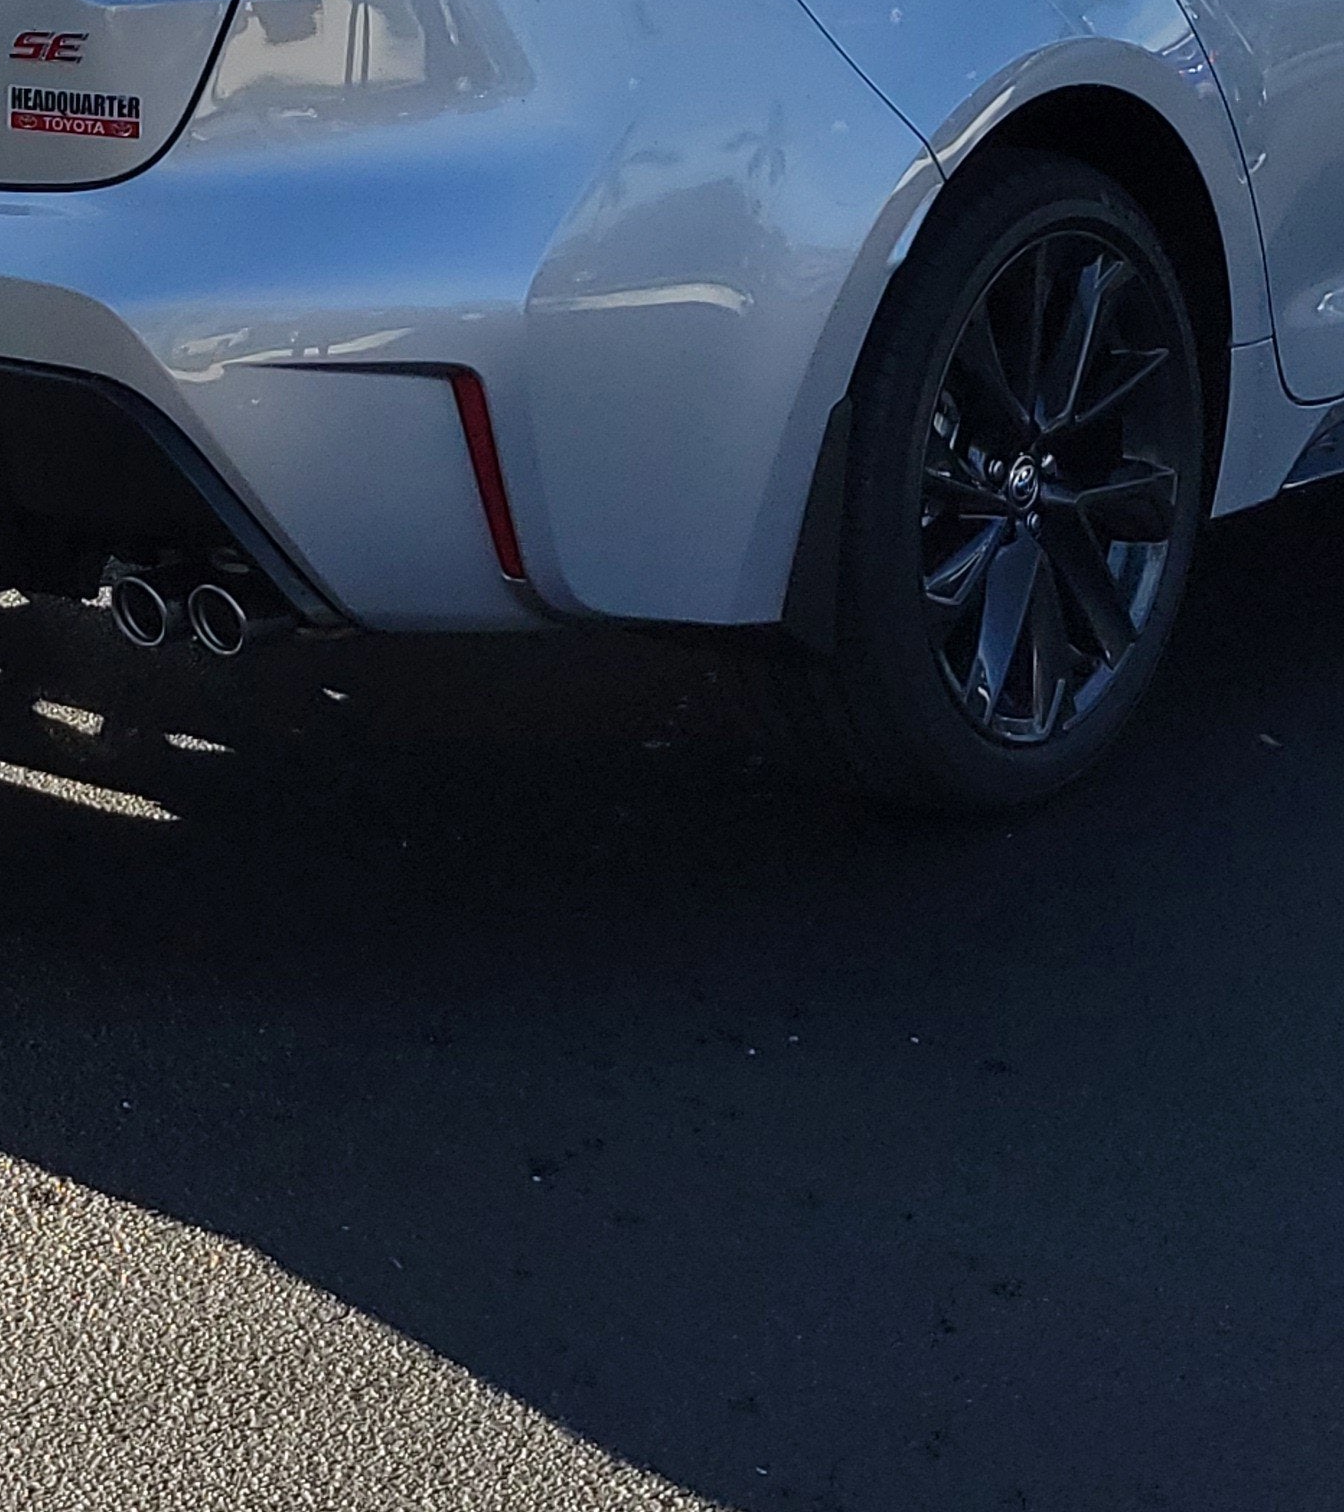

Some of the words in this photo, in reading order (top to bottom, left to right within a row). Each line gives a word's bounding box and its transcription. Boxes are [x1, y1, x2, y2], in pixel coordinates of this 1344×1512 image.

[9, 31, 89, 64] SE
[11, 86, 140, 120] HEADQUARTER
[42, 116, 105, 135] TOYOTA
